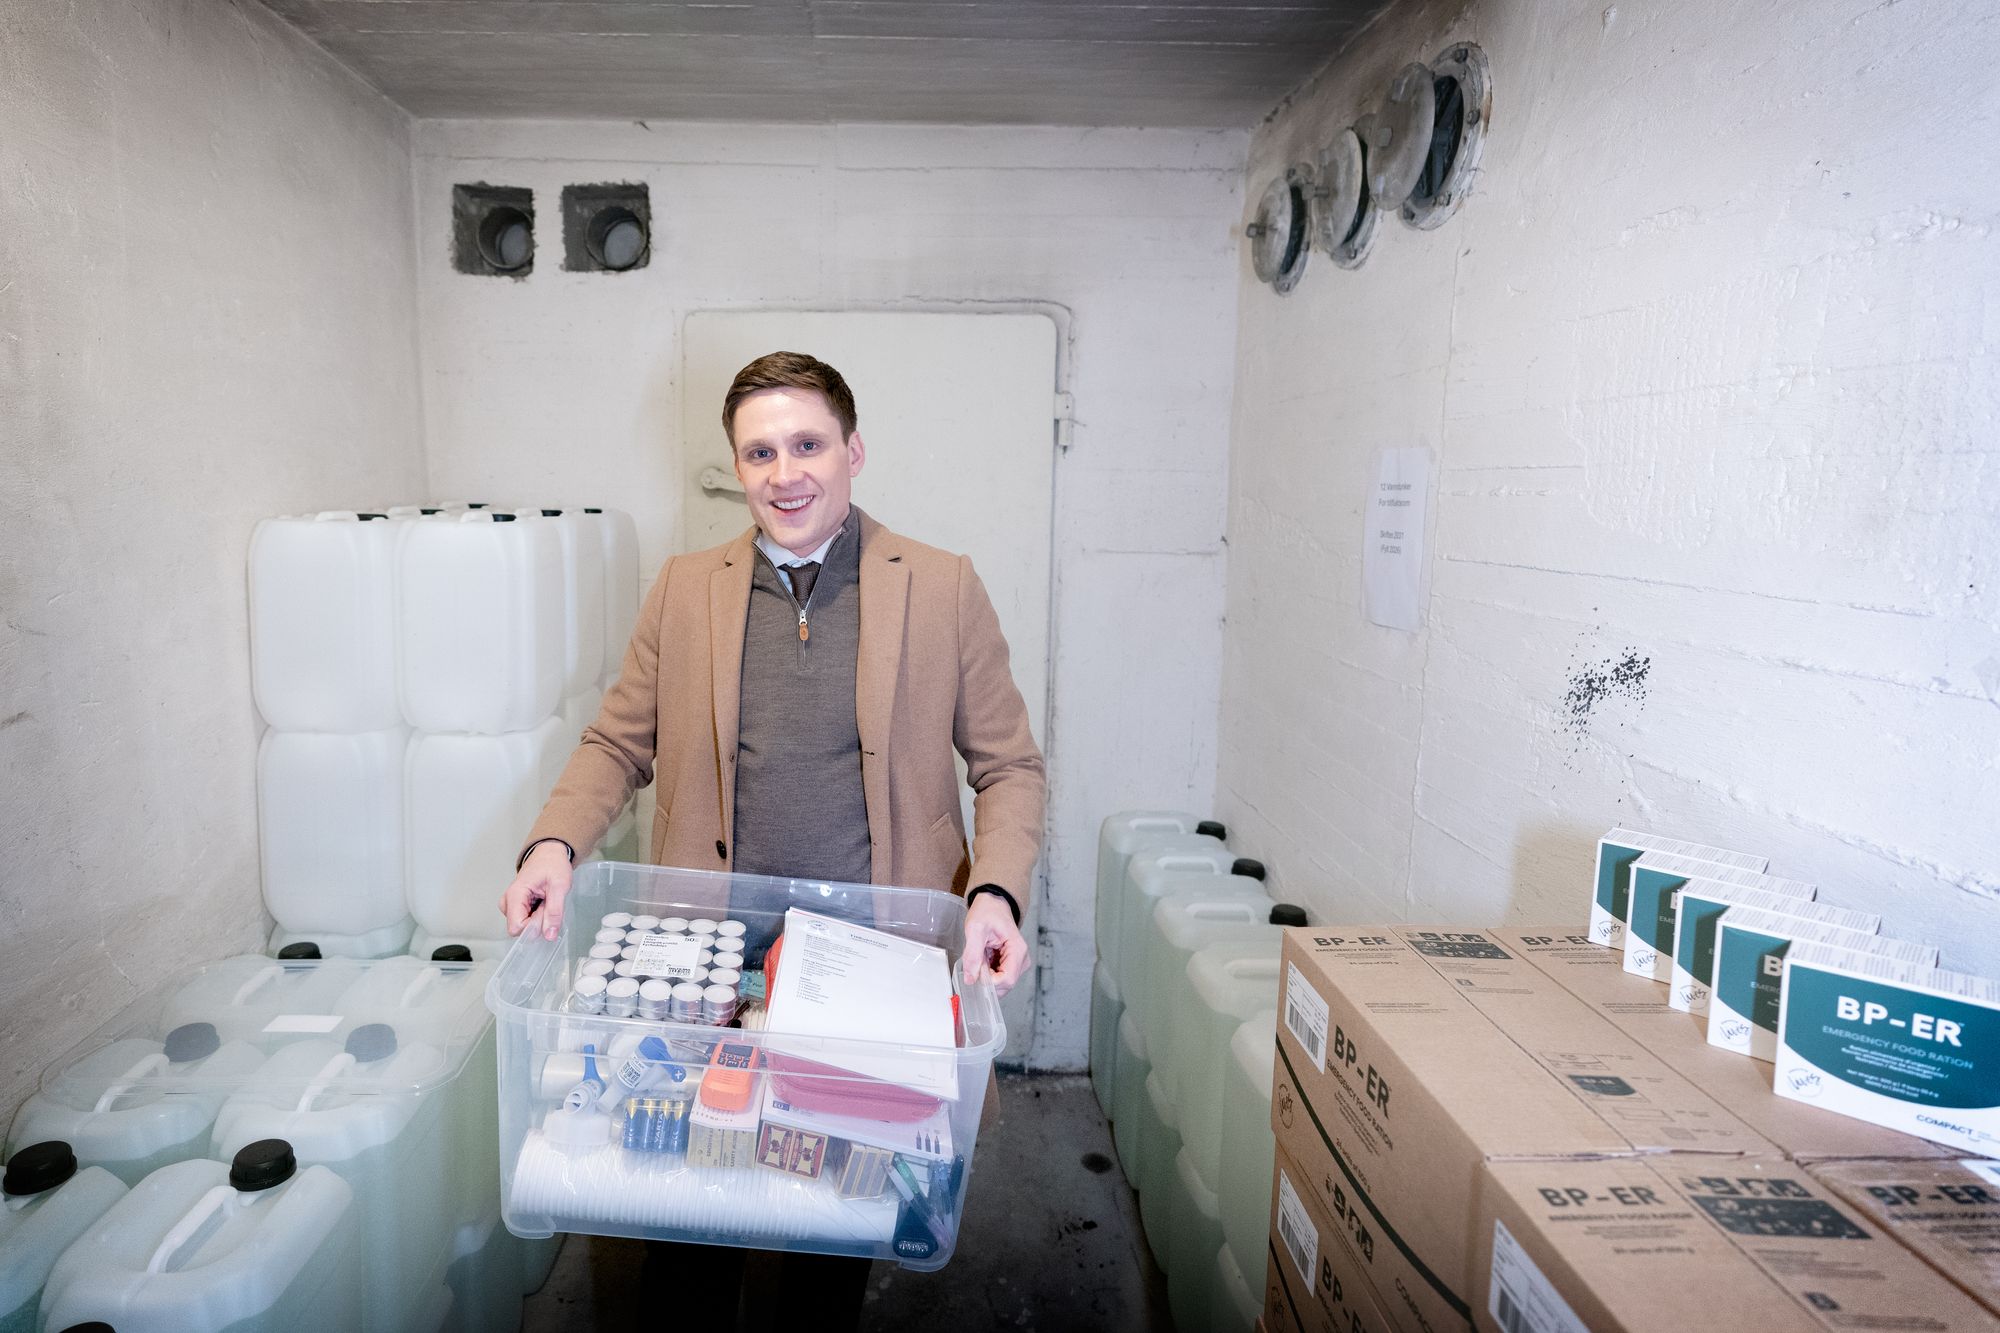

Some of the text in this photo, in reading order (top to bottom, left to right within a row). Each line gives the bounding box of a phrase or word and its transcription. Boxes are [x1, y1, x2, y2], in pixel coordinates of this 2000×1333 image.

[1313, 937, 1392, 946] BP-ER
[1836, 995, 1963, 1047] BP-ER
[1822, 1025, 1974, 1070] EMERGENCY FOOD RATION
[1333, 1024, 1390, 1120] BP-ER
[1915, 1113, 1973, 1136] COMPACT
[1538, 1186, 1666, 1207] BP-ER
[1322, 1255, 1369, 1333] BP-E
